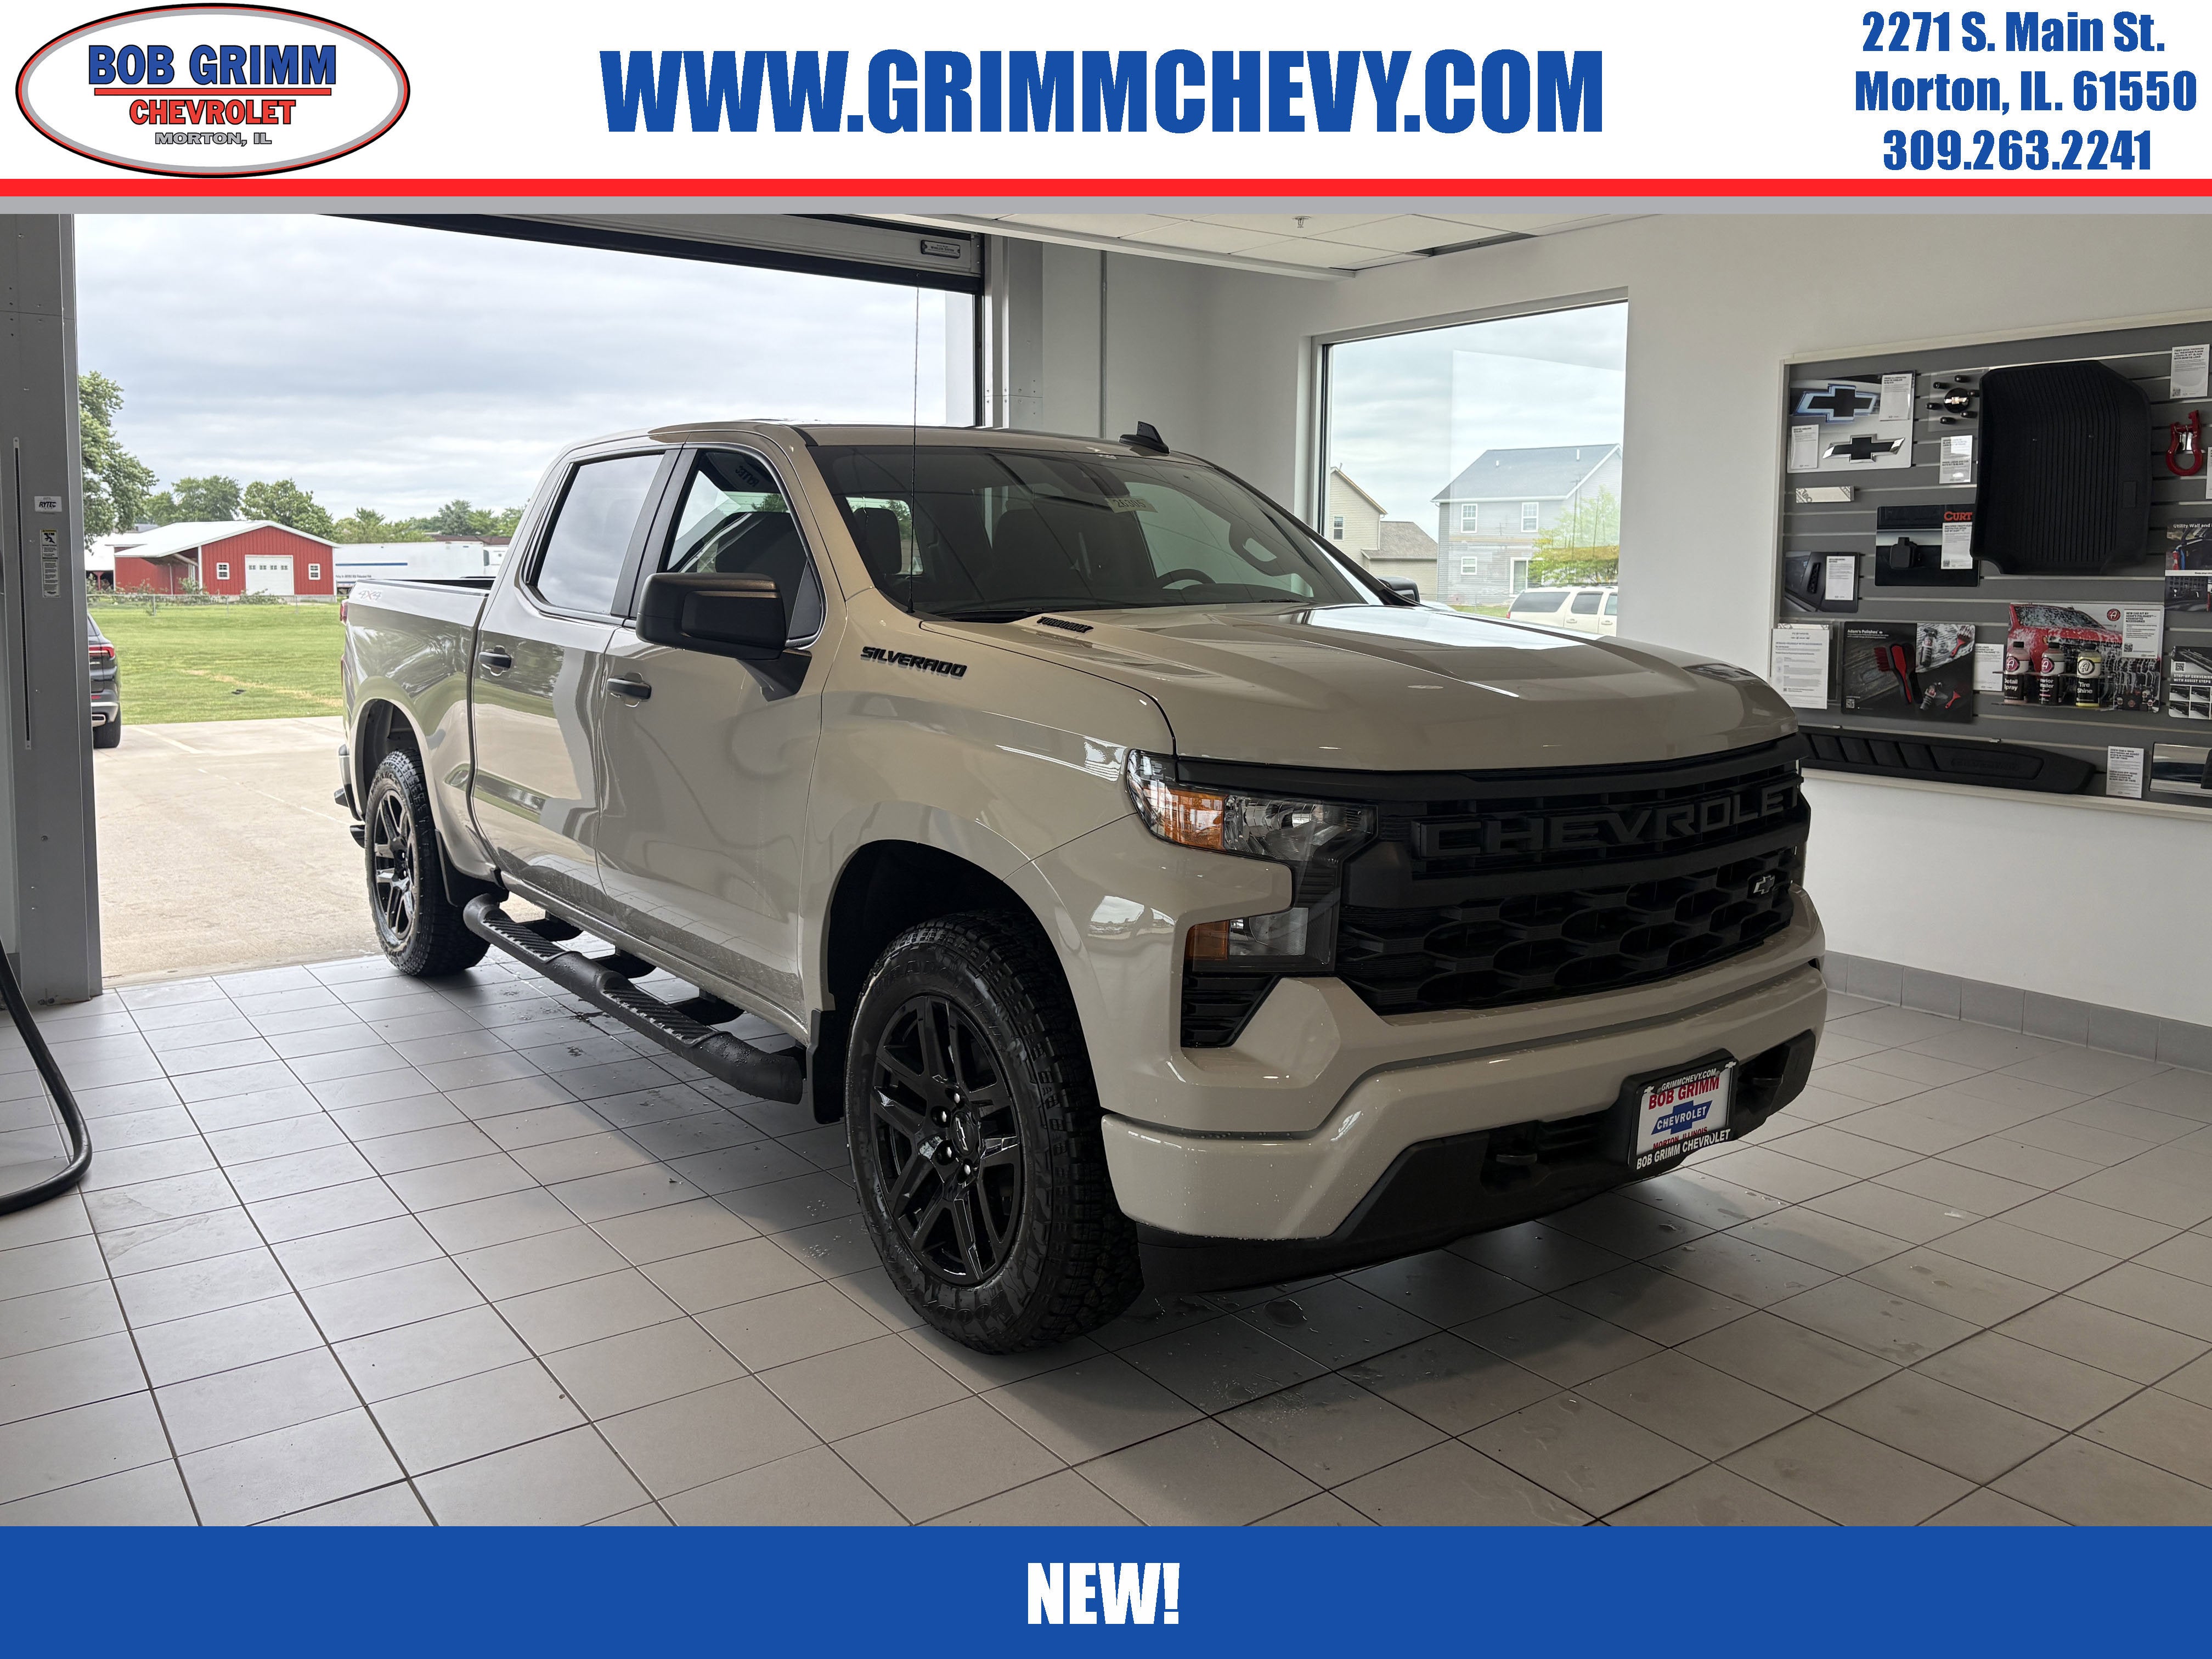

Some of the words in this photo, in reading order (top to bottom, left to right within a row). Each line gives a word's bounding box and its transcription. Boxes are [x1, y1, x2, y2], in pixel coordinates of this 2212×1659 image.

[1113, 499, 1146, 509] 26305
[1944, 511, 1973, 522] CURT
[860, 645, 968, 678] SILVERADO
[1419, 783, 1799, 857] CHEVROLET
[1649, 1091, 1674, 1110] BOB
[1678, 1077, 1719, 1099] GRIMM
[1662, 1068, 1717, 1091] GRIMMCHEVY.COM
[1657, 1105, 1707, 1130] CHEVROLET
[1637, 1153, 1652, 1170] BOB
[1654, 1144, 1680, 1162] GRIMM
[1682, 1128, 1731, 1152] CHEVROLET
